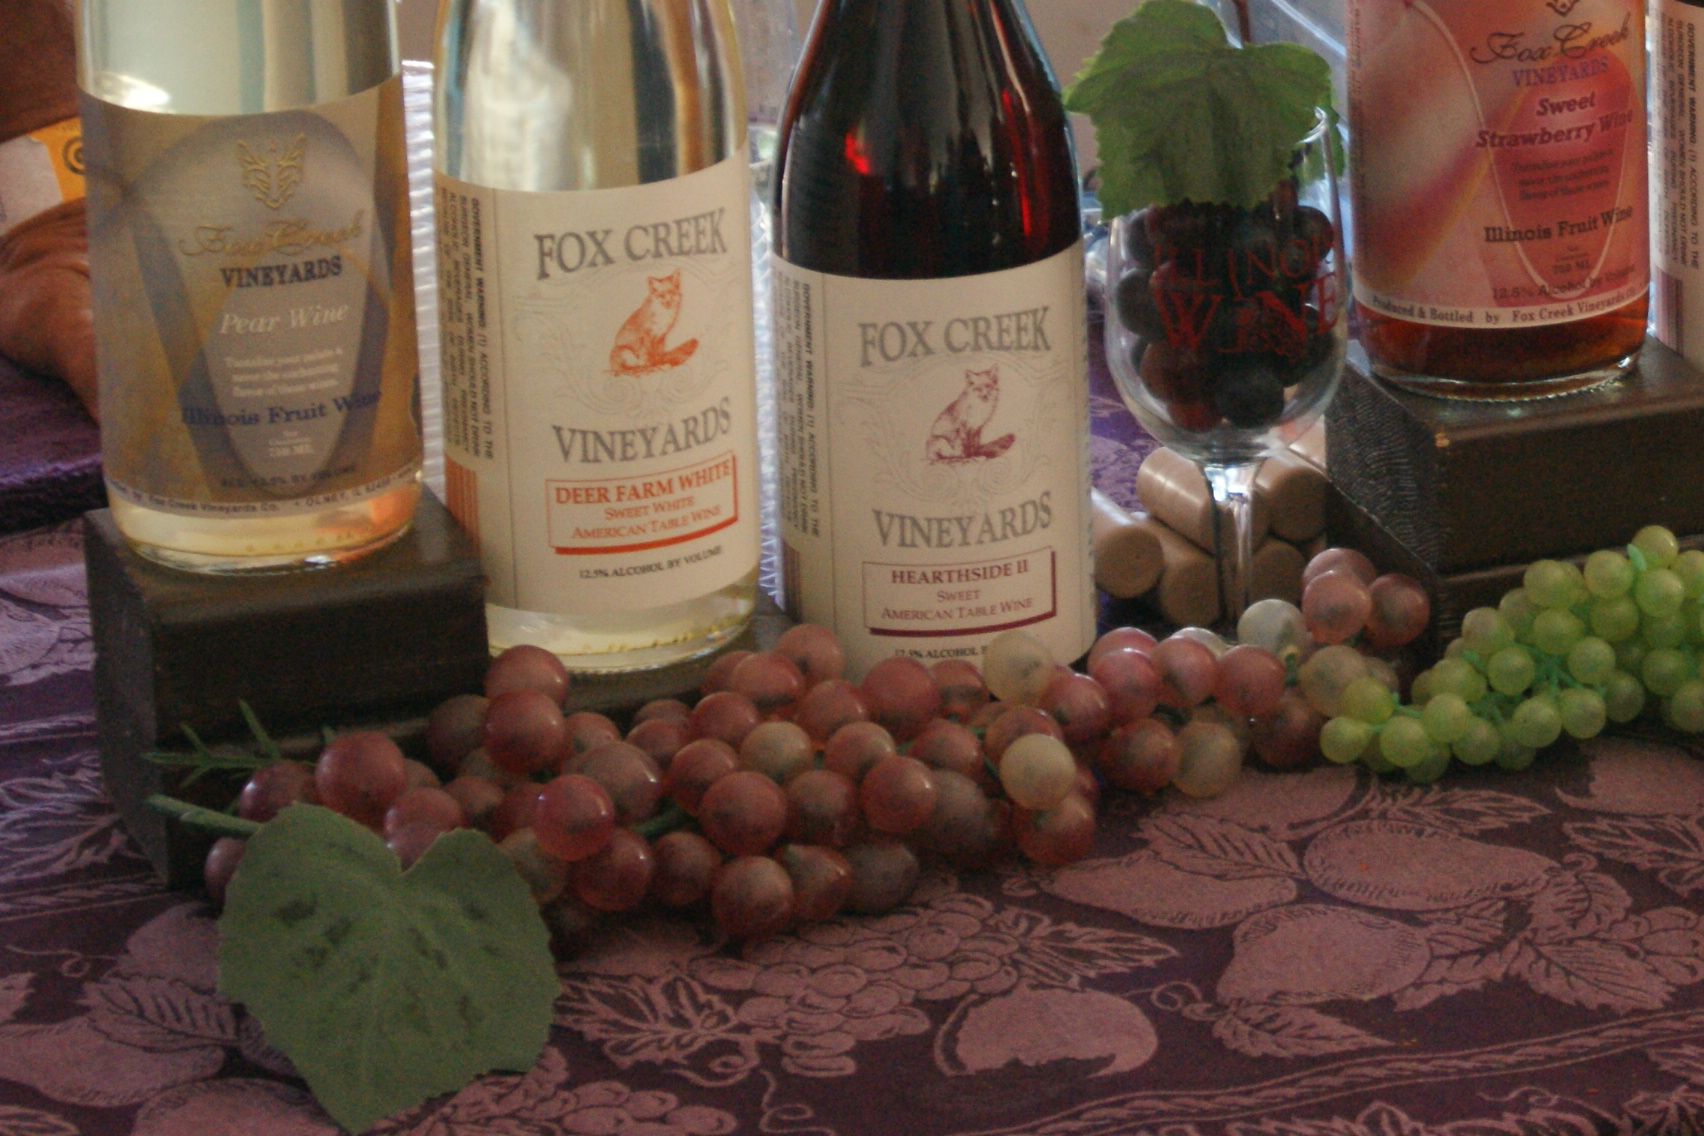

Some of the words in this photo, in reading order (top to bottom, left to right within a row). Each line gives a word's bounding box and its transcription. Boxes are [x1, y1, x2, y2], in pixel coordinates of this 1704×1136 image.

[1469, 31, 1552, 64] Fox
[1553, 12, 1631, 60] Creek
[1512, 55, 1608, 87] VINEYARDS
[1536, 91, 1595, 116] Sweet
[1475, 123, 1595, 148] Strawberry
[1598, 109, 1633, 133] Wine
[1484, 225, 1552, 242] Illinois
[1557, 216, 1598, 237] Fruit
[1600, 206, 1633, 226] Wine
[534, 227, 616, 280] FOX
[624, 208, 728, 261] CREEK
[220, 255, 343, 288] VINEYARDS
[218, 313, 281, 335] Pear
[287, 305, 349, 329] Wine
[1430, 308, 1474, 323] Bottled
[1485, 311, 1499, 324] by
[1512, 310, 1535, 322] Fox
[1539, 305, 1574, 320] Creek
[858, 320, 935, 366] FOX
[944, 306, 1051, 354] CREEK
[267, 403, 327, 424] Fruit
[552, 397, 731, 463] VINEYARDS
[555, 485, 612, 504] DEER
[615, 480, 674, 503] FARM
[679, 459, 730, 492] WHITE
[572, 524, 646, 540] AMERICAN
[649, 515, 689, 534] TABLE
[691, 505, 721, 524] WINE
[604, 504, 649, 521] SWEET
[654, 495, 695, 516] WHITE
[872, 491, 1051, 548] VINEYARDS
[611, 563, 664, 578] ALCOHOL
[667, 558, 682, 571] BY
[684, 546, 723, 566] VOLUME
[891, 564, 1013, 585] HEARTHSIDE
[1016, 560, 1029, 574] II
[881, 607, 954, 620] AMERICAN
[957, 604, 998, 618] TABLE
[1000, 597, 1034, 613] WINE
[937, 590, 980, 603] SWEET
